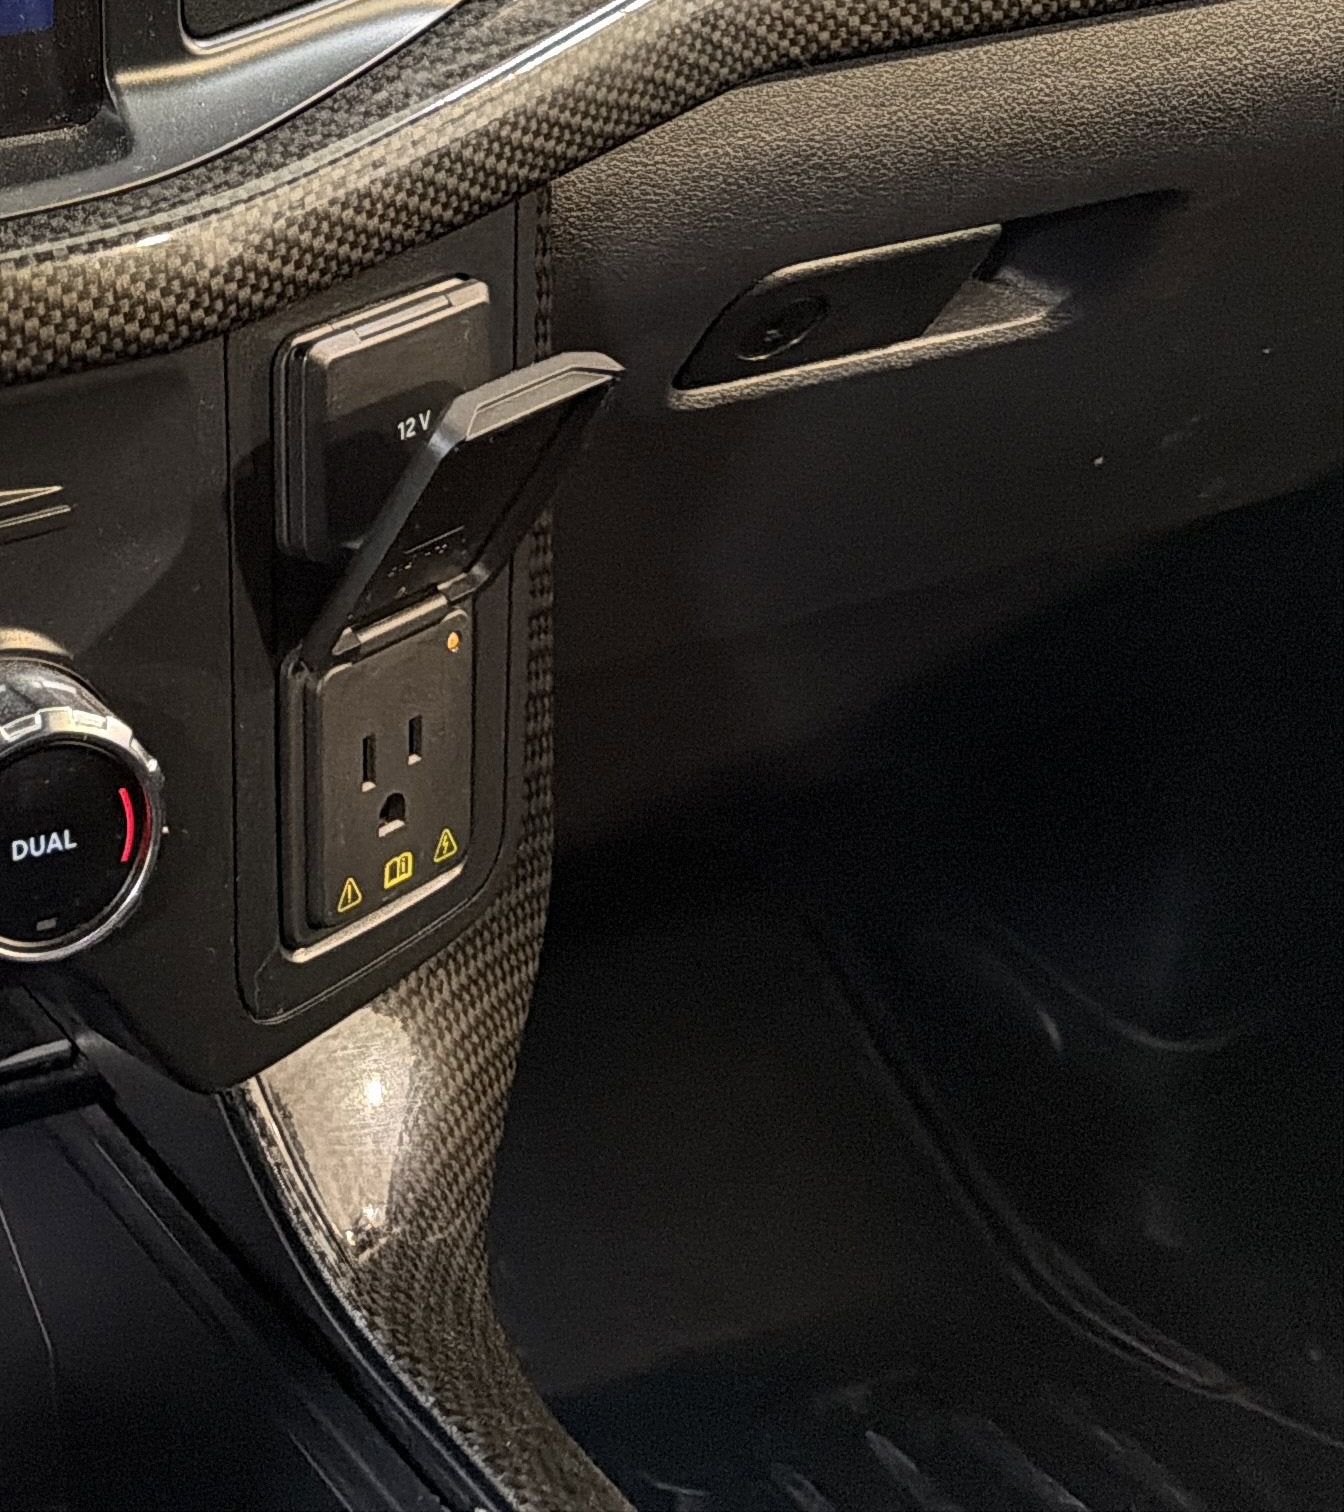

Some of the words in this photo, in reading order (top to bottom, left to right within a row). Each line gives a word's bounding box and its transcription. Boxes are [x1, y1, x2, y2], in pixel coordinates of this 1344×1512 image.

[396, 414, 418, 442] 12
[417, 407, 433, 433] V
[11, 829, 78, 862] DUAL
